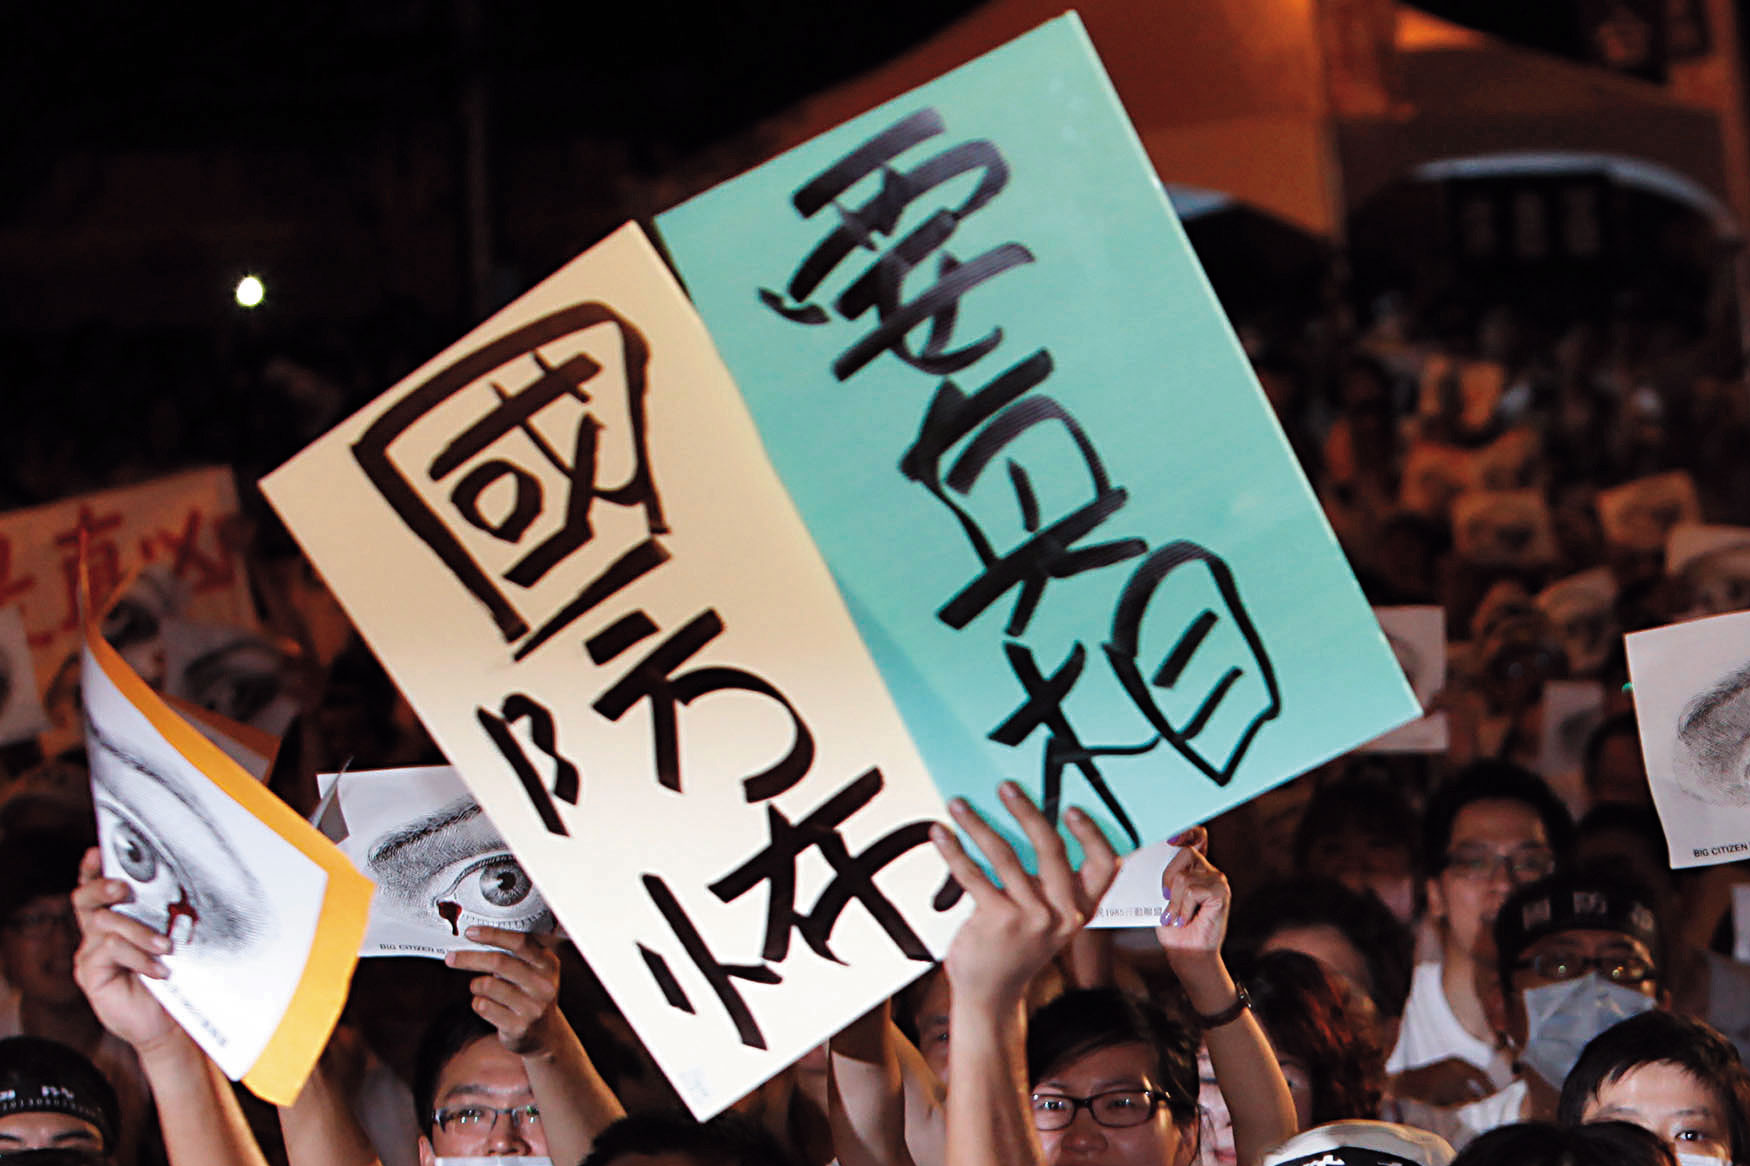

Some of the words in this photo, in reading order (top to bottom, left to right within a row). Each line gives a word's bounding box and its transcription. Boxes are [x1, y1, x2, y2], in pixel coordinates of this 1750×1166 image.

[758, 107, 1281, 846] 要真相
[1693, 848, 1709, 858] BIG
[1711, 843, 1748, 857] CITIZEN
